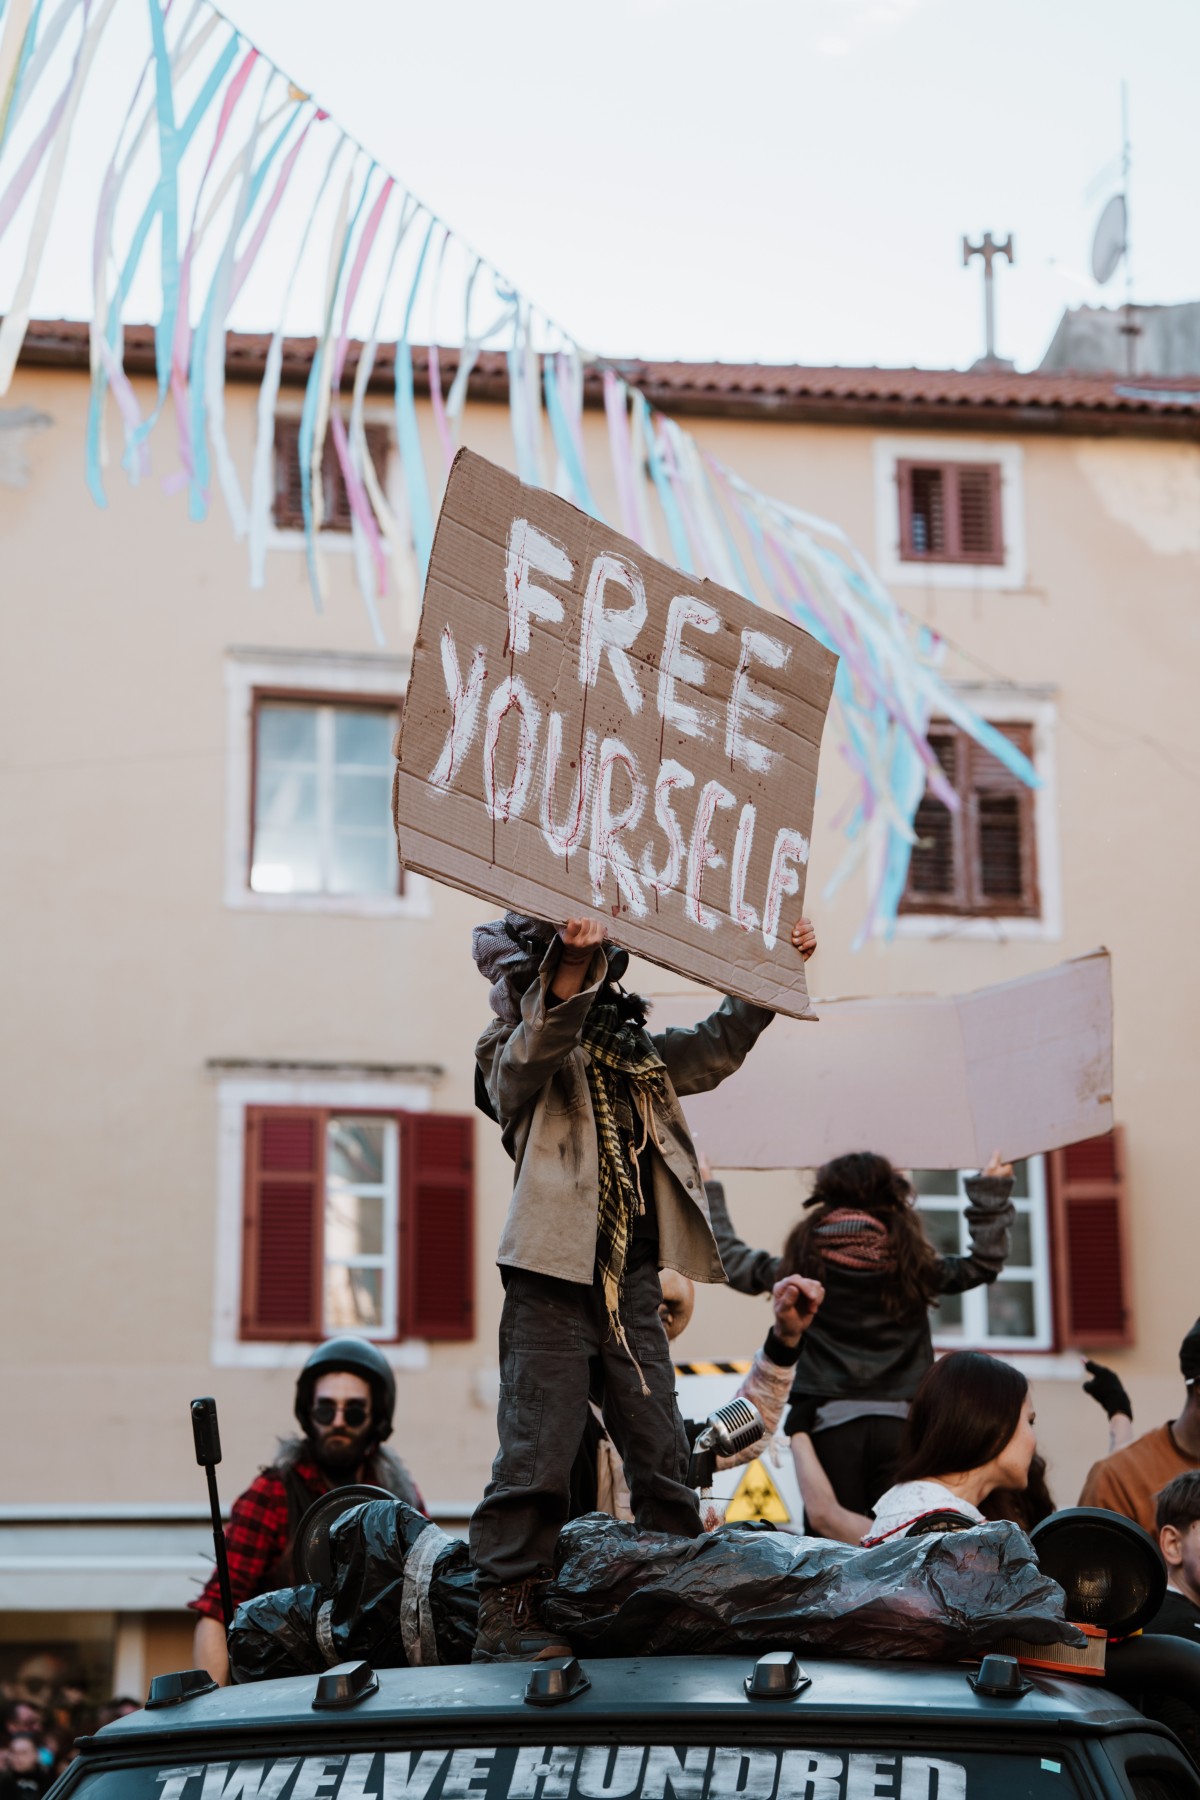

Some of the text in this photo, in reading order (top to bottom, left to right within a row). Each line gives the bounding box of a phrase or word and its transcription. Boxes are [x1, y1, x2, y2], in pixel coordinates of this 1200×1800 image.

[505, 517, 792, 774] FREE
[429, 622, 808, 950] YOURSELF
[155, 1746, 966, 1800] TWELVE HUNDRED
